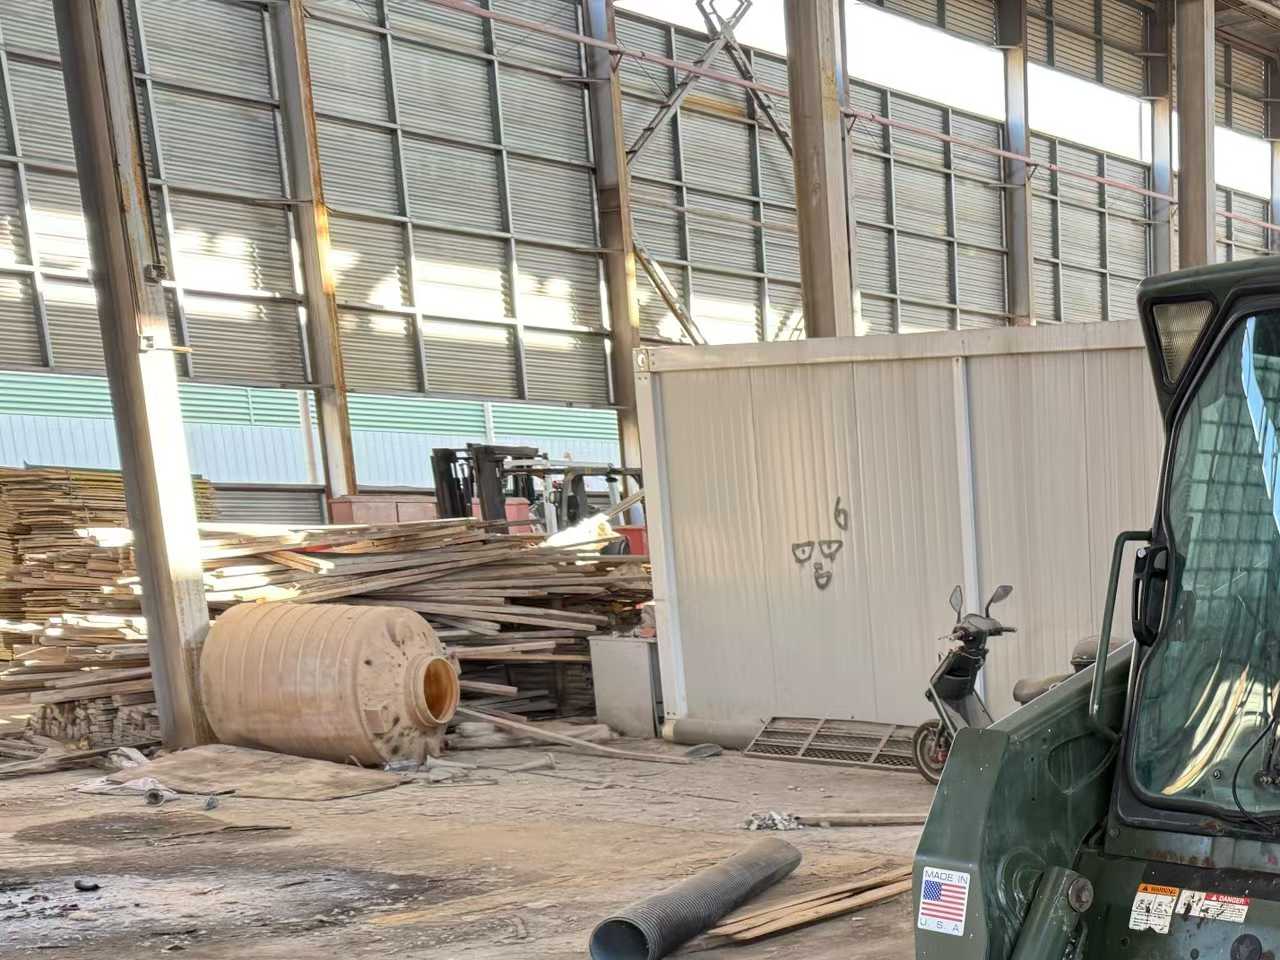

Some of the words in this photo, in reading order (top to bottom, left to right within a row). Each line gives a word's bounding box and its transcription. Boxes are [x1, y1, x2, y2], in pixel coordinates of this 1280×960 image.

[925, 870, 954, 882] MADE
[956, 874, 968, 885] IN
[1219, 895, 1245, 905] DANGER
